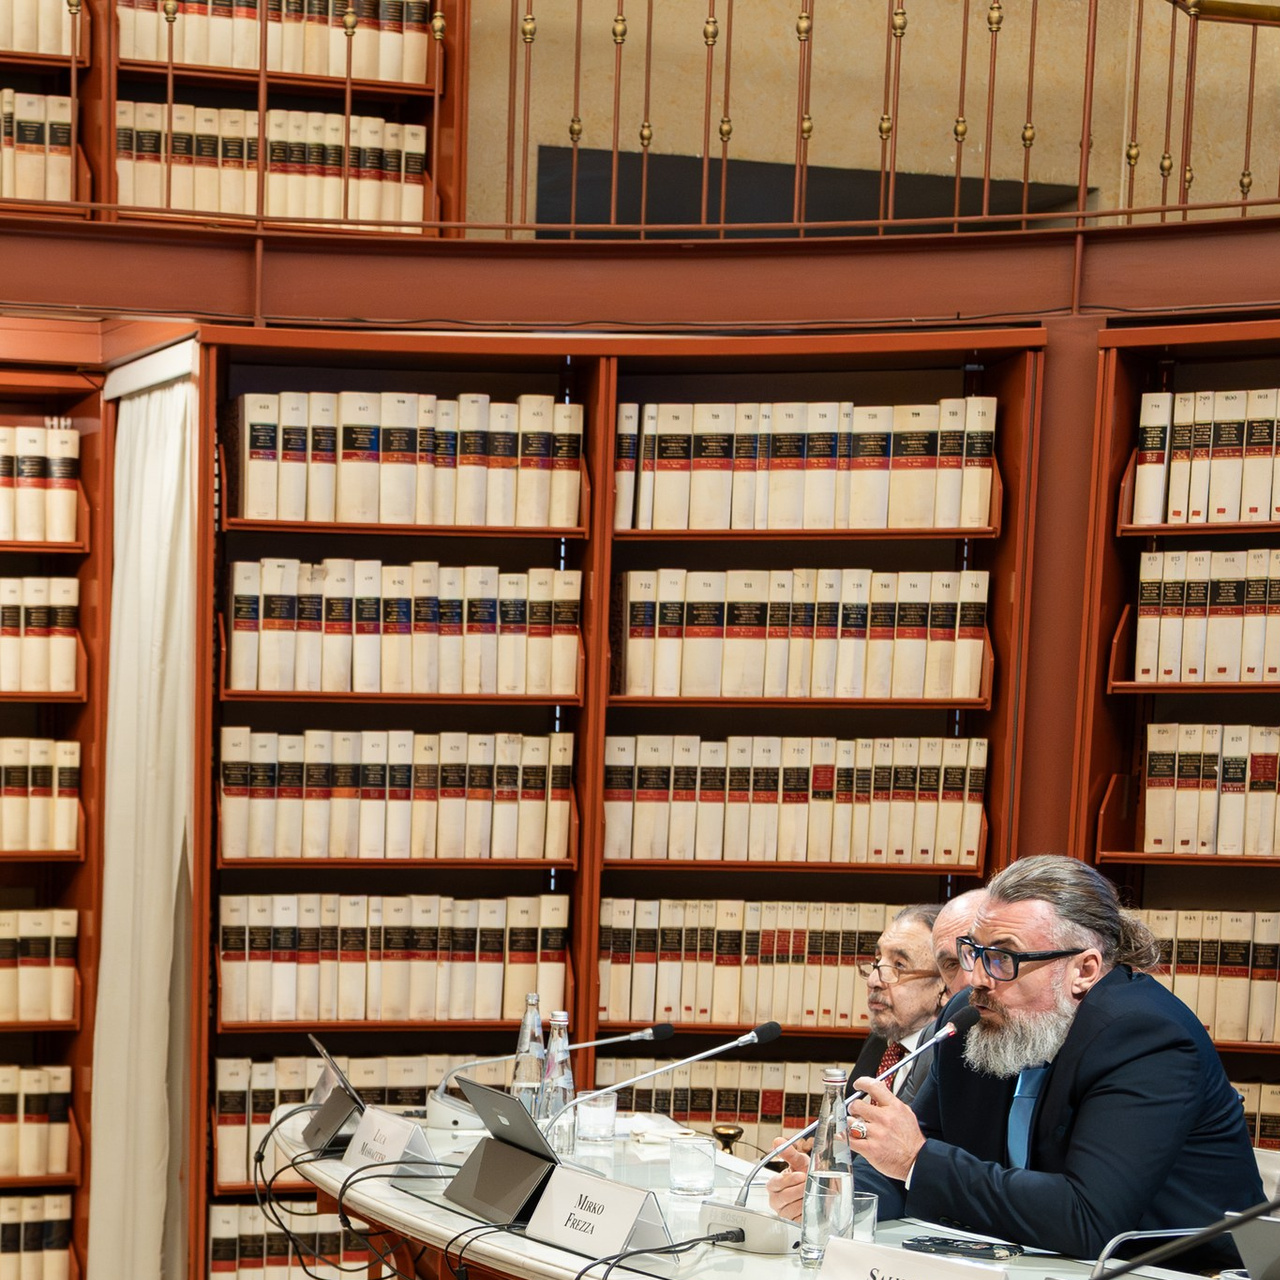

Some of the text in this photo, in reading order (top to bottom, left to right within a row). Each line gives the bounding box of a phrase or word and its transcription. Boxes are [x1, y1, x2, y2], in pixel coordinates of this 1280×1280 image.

[574, 1193, 605, 1216] MIRKO
[563, 1212, 595, 1236] FREZZA
[720, 1212, 747, 1225] BOSCH
